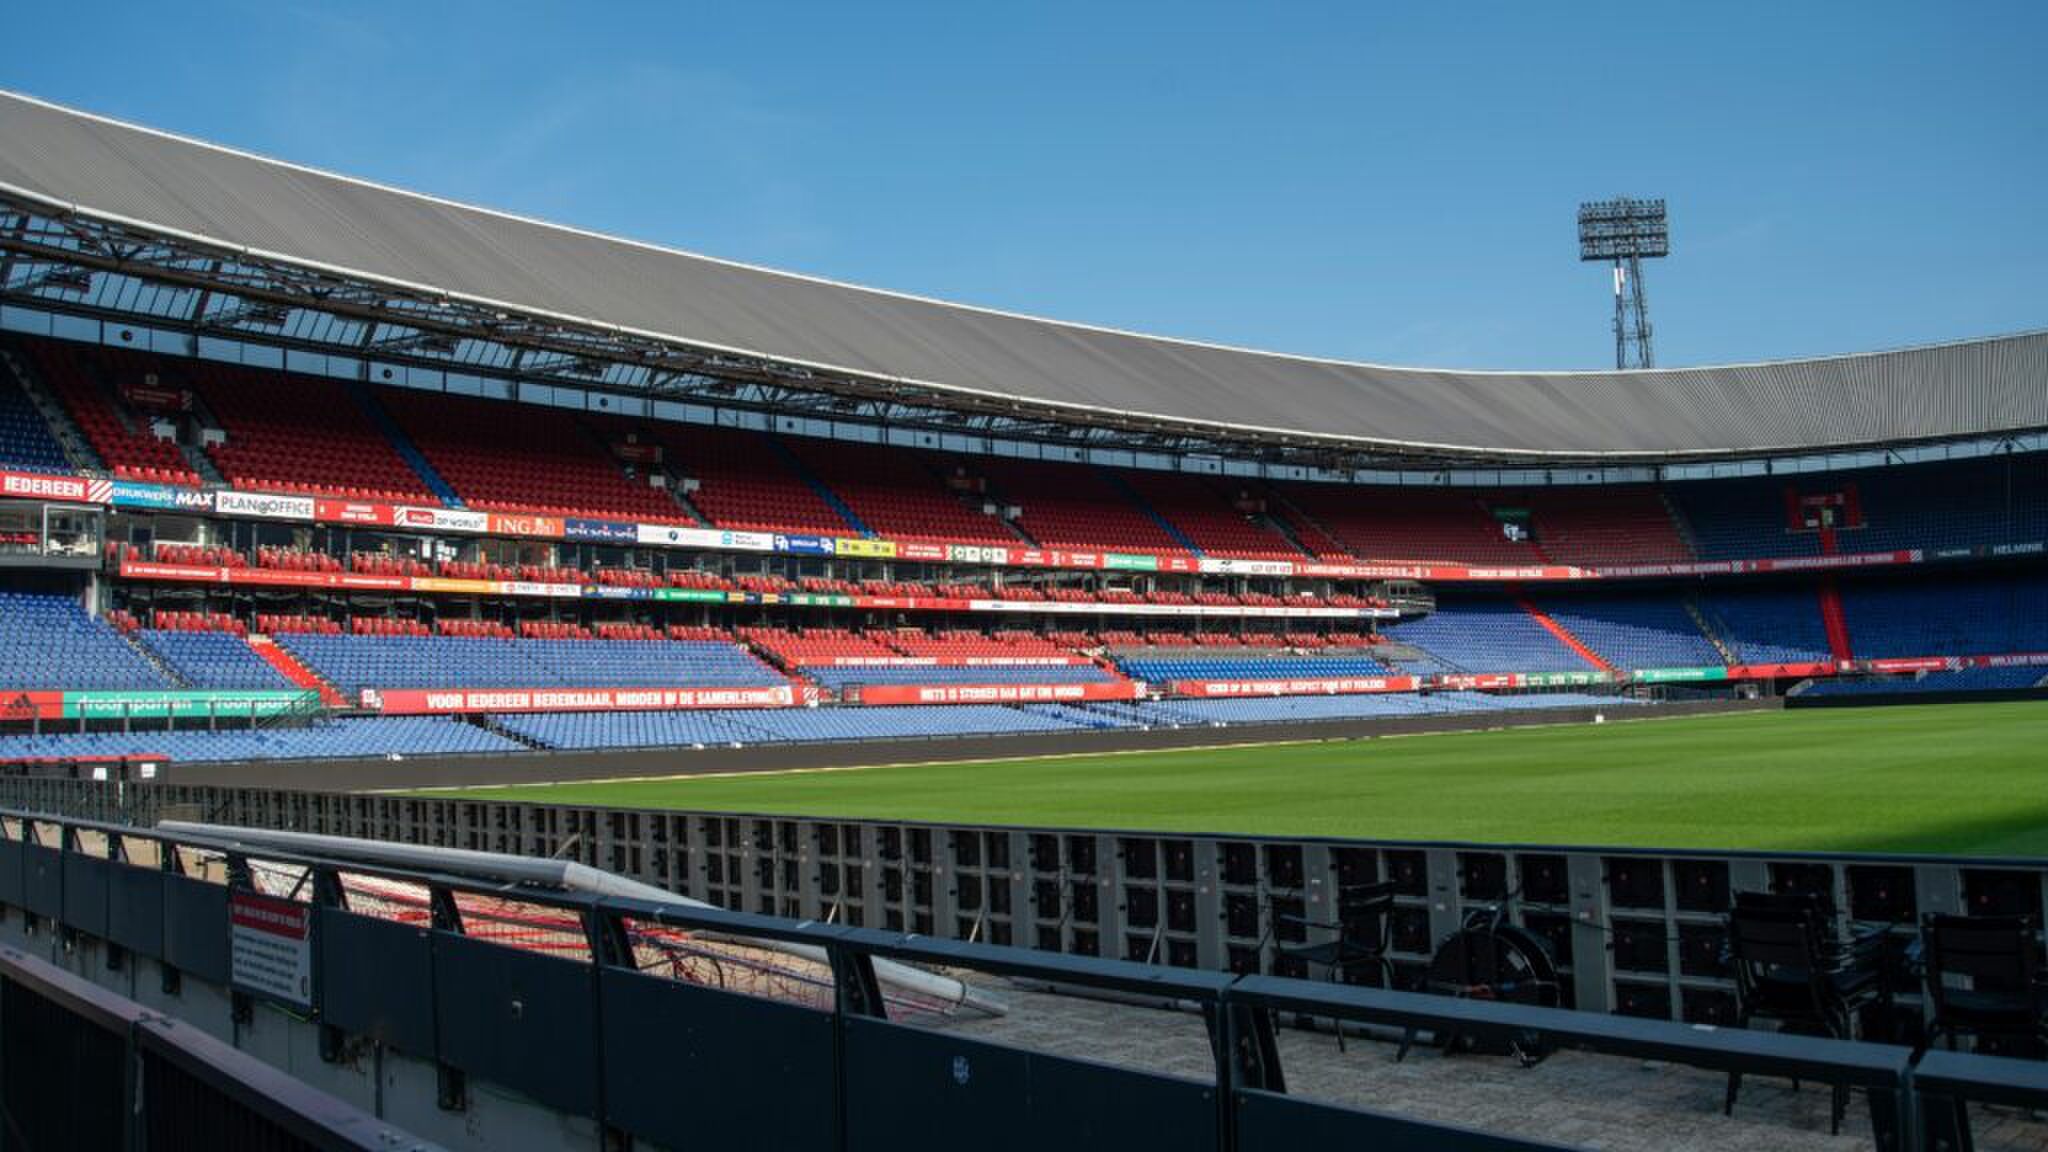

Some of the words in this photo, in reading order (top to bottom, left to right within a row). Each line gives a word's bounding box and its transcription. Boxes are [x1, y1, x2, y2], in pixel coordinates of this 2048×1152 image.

[4, 475, 84, 497] IEDEREEN
[175, 491, 215, 507] MAX
[221, 496, 311, 515] PLAN@OFFICE
[450, 517, 480, 529] WORLD
[495, 517, 530, 534] ING
[426, 693, 464, 709] VOOR
[467, 692, 530, 708] IEDEREEN
[616, 691, 662, 706] MIDDEN
